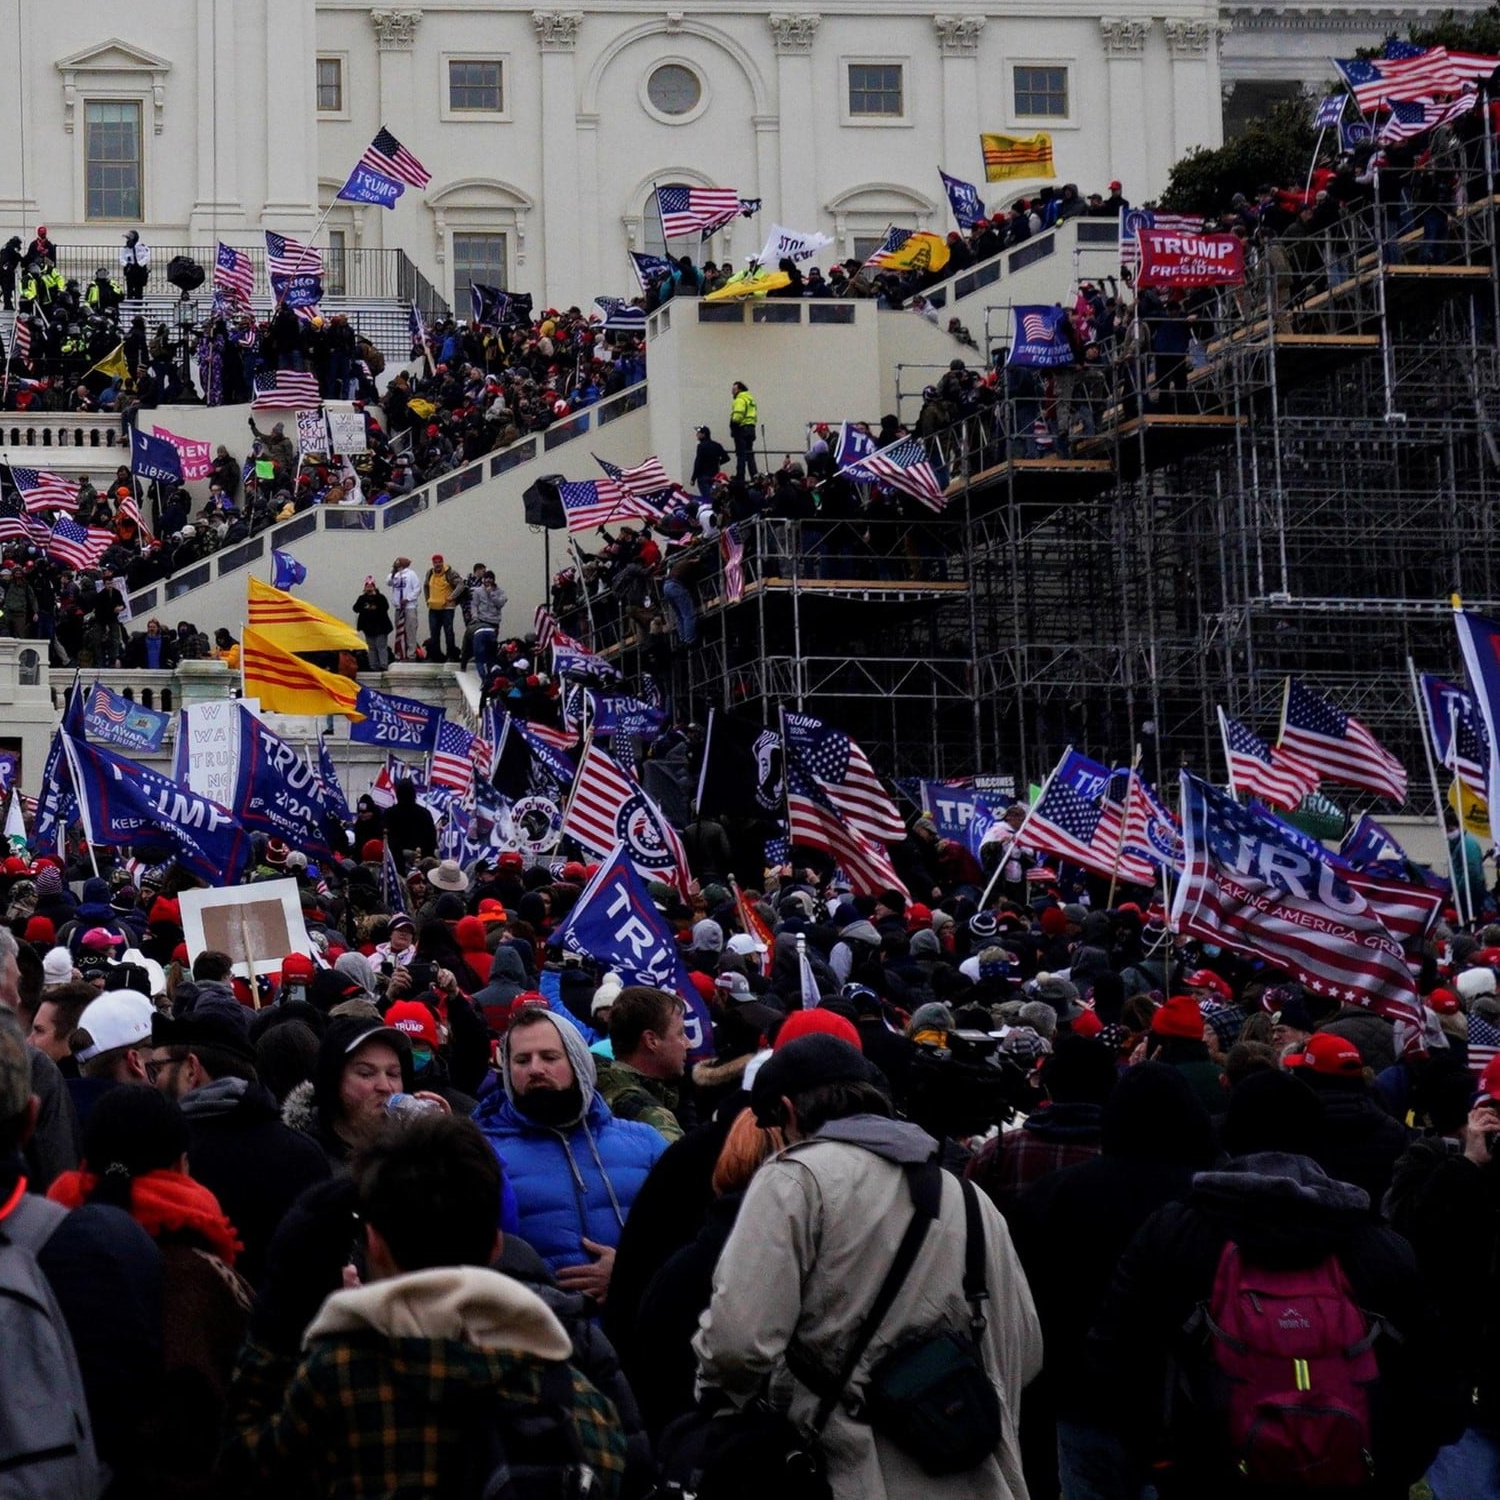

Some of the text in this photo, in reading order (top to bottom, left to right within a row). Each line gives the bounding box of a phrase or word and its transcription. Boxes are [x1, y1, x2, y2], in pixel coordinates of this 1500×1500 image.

[356, 170, 398, 196] TRUMP
[1150, 237, 1234, 259] TRUMP
[1150, 265, 1235, 277] PRESIDENT
[94, 716, 149, 746] DELAWARE
[370, 709, 425, 732] TRUMP
[785, 714, 823, 729] TRUMP
[93, 727, 142, 750] FOR TRUMP
[376, 723, 422, 744] 2020
[974, 776, 1015, 788] VACCINES
[111, 817, 148, 830] KEEP
[1213, 872, 1270, 911] MAKING
[1271, 906, 1358, 944] AMERICA
[394, 1022, 424, 1032] TRUMP
